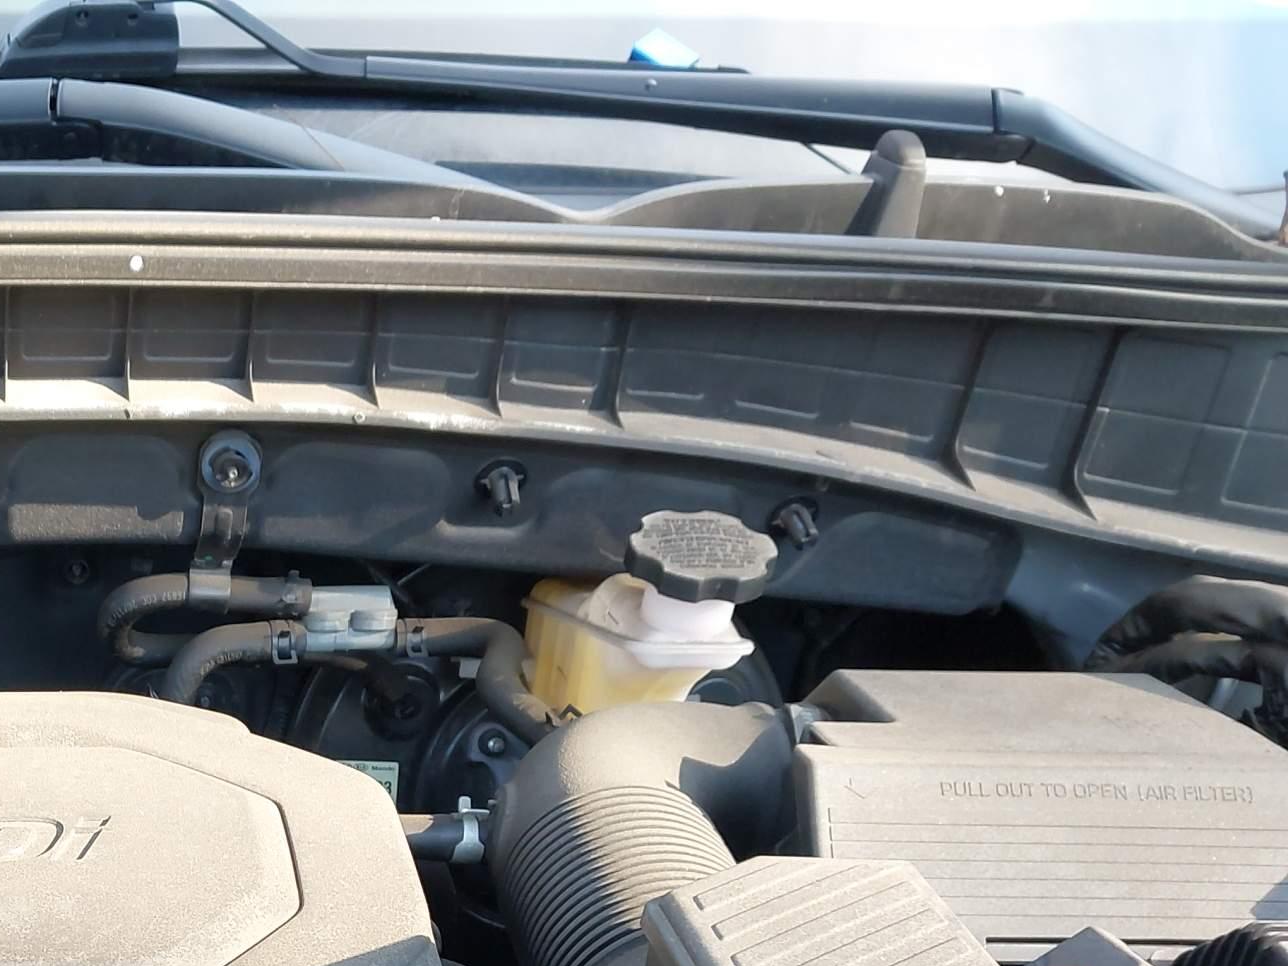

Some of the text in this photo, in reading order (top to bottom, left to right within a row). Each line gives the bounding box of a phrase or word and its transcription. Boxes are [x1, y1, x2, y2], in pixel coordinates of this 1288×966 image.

[939, 781, 990, 798] PULL
[995, 782, 1033, 798] OUT
[1040, 783, 1067, 798] TO
[1073, 783, 1128, 800] OPEN
